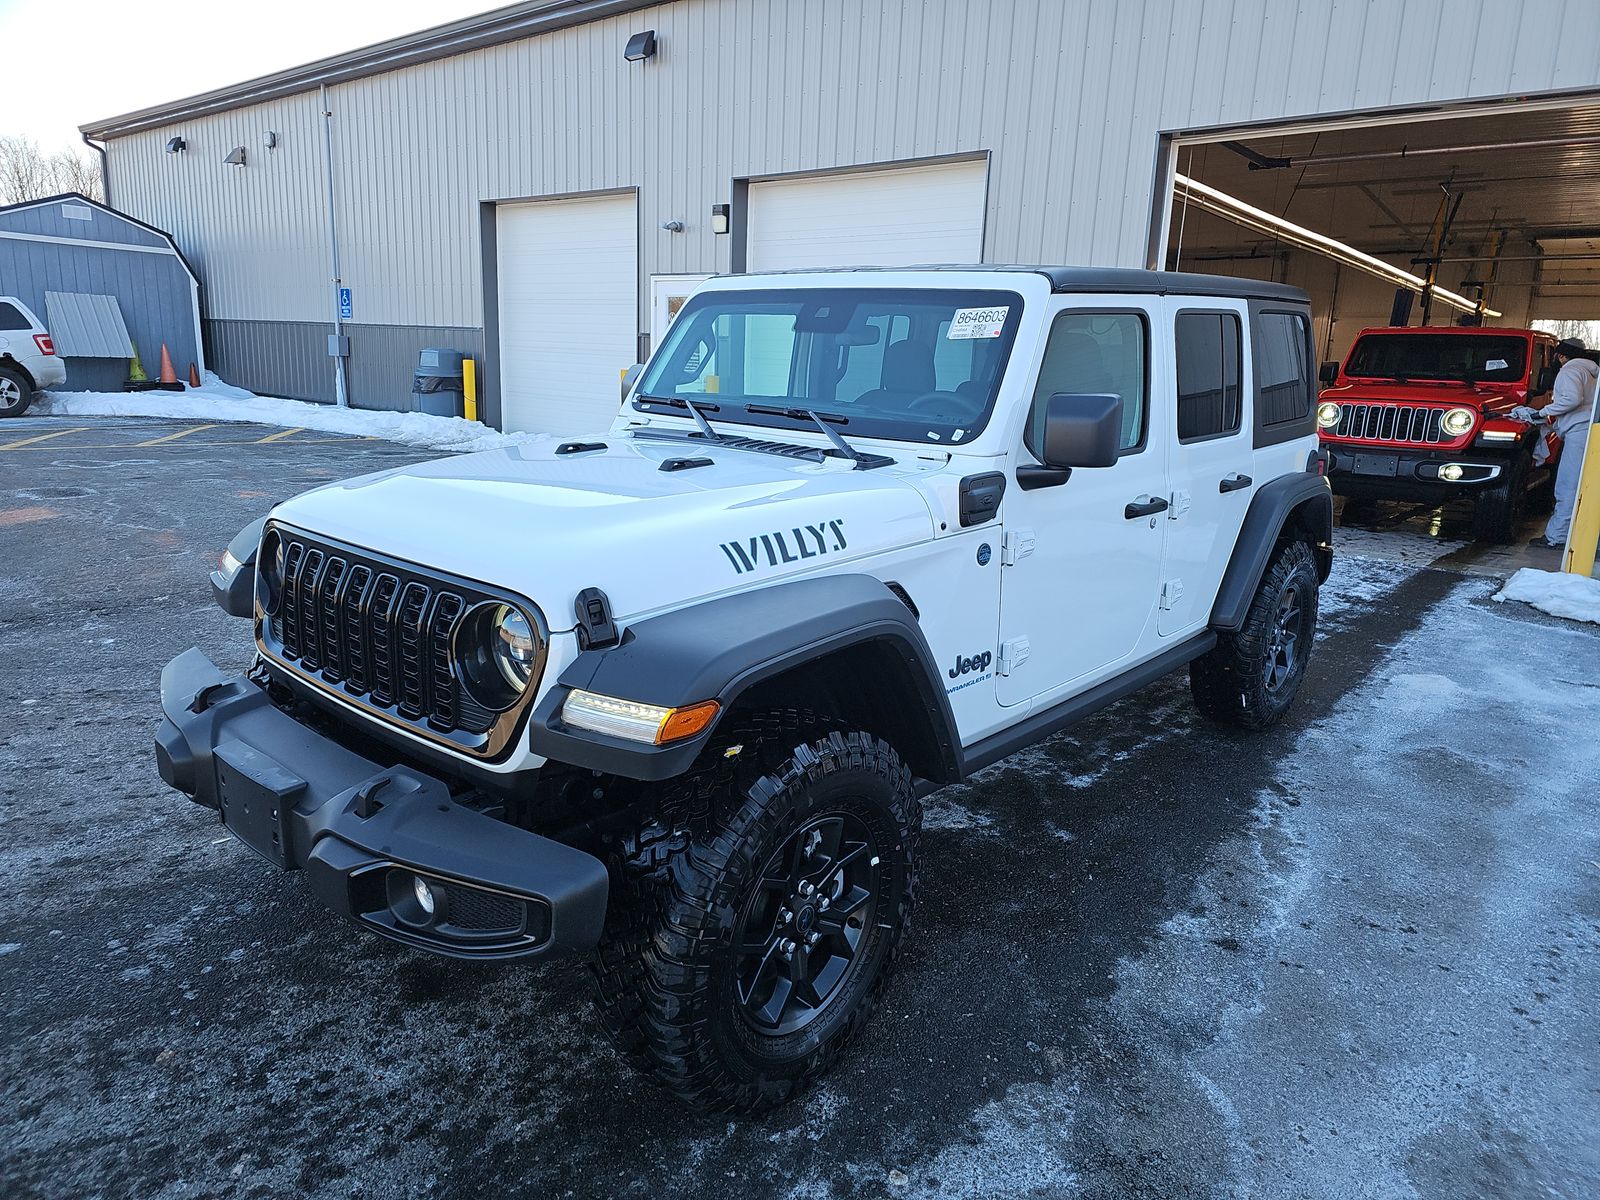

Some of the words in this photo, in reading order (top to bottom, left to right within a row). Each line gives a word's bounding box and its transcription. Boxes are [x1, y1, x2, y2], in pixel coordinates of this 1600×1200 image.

[957, 310, 1006, 324] 8646603
[719, 518, 847, 574] WILLYS
[948, 650, 992, 679] Jeep
[946, 676, 985, 694] WRANGLER
